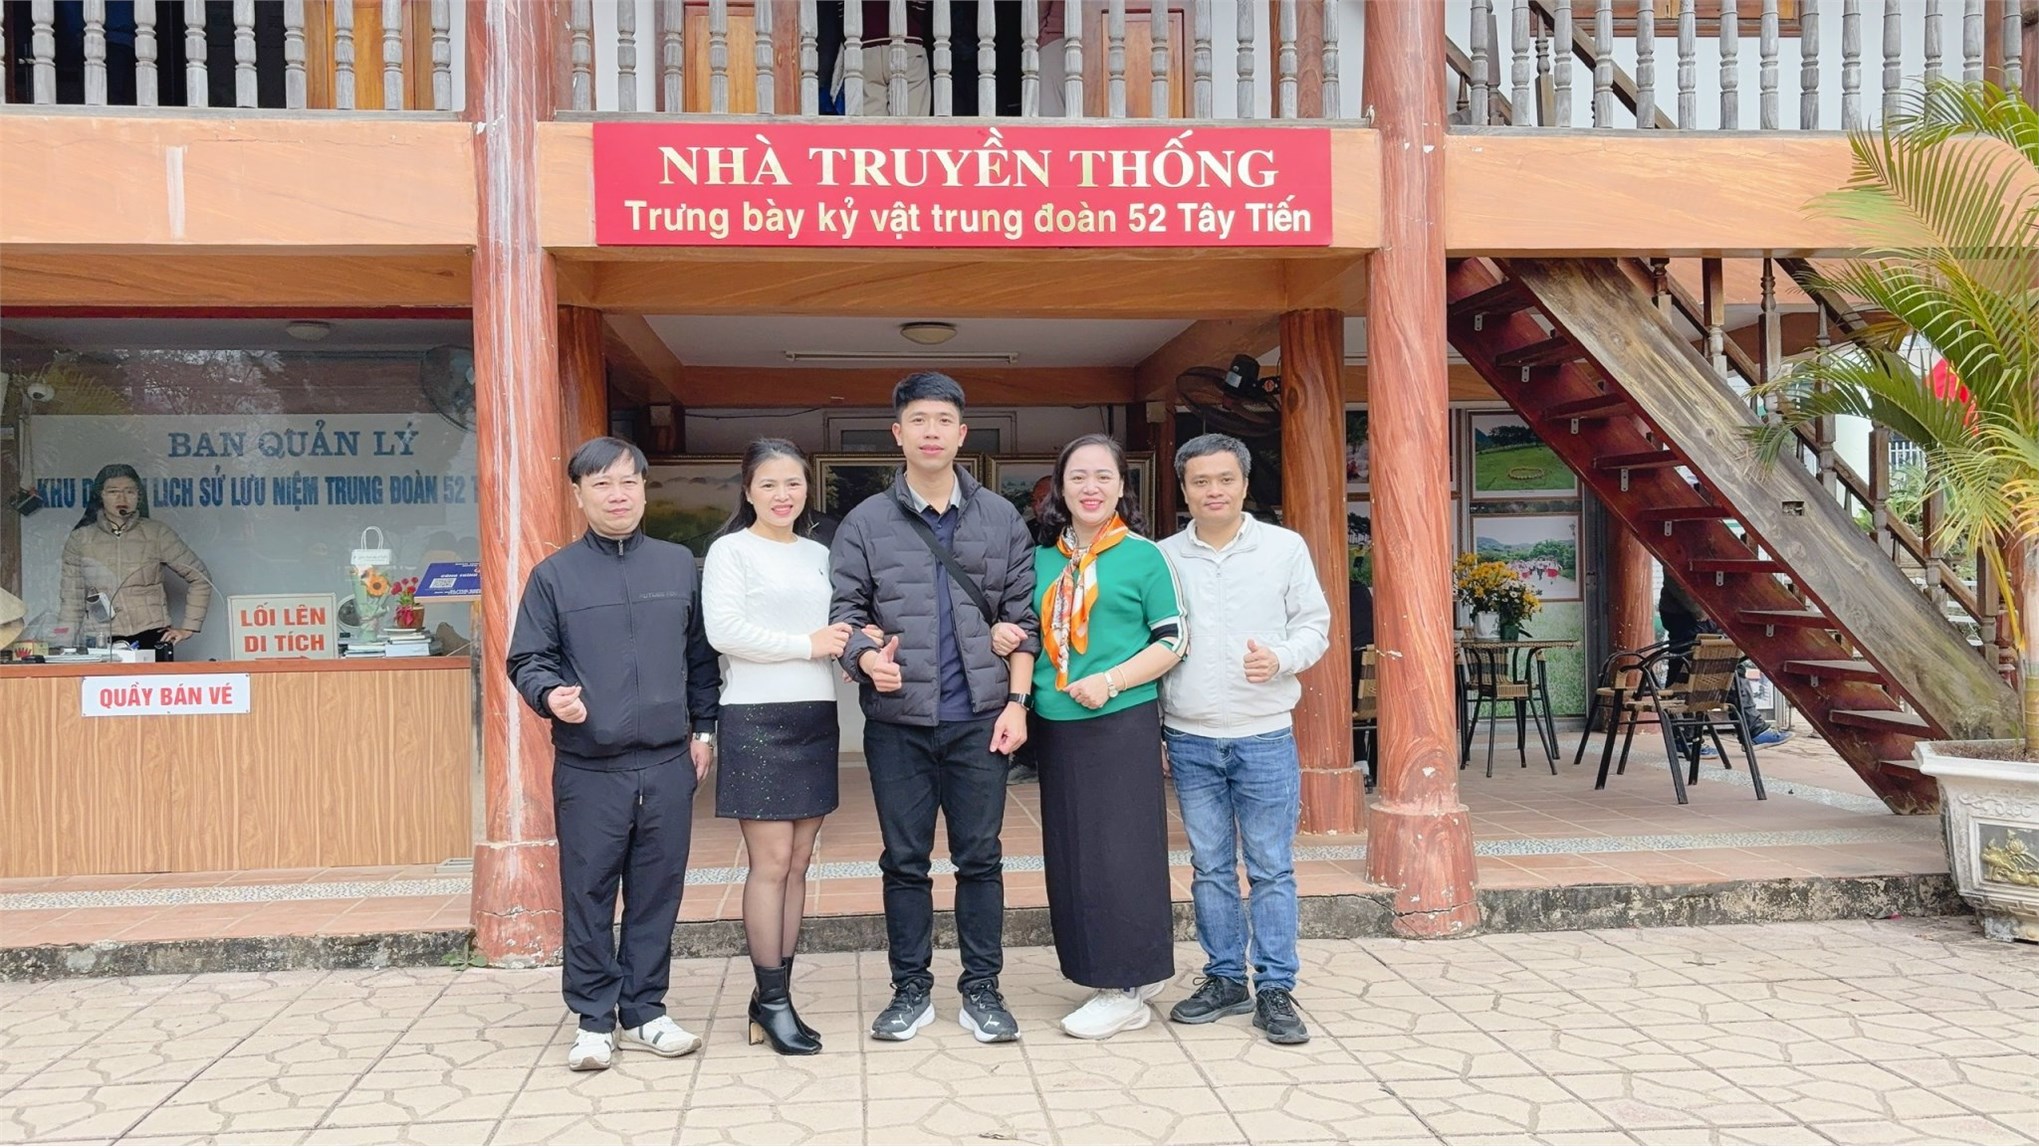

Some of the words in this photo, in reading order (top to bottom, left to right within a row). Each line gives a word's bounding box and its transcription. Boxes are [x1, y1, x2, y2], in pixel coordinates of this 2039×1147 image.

[658, 133, 793, 185] NHÀ
[809, 127, 1052, 188] TRUYỀN
[1069, 129, 1279, 188] THỐNG
[624, 199, 729, 238] Trưng
[743, 198, 805, 239] bày
[818, 196, 858, 239] kỷ
[870, 201, 920, 239] vật
[931, 203, 1023, 239] trung
[1034, 201, 1116, 233] đoàn
[1128, 203, 1167, 232] 52
[1177, 202, 1235, 239] Tây
[1245, 195, 1311, 233] Tiến
[168, 432, 247, 457] BAN
[258, 419, 360, 459] QUẢN
[373, 421, 419, 456] LÝ
[36, 477, 76, 508] KHU
[199, 464, 226, 508] SỬ
[231, 474, 266, 507] LƯU
[325, 475, 383, 506] TRUNG
[390, 469, 438, 505] ĐOÀN
[443, 475, 465, 504] 52
[240, 602, 276, 627] LỐI
[283, 604, 326, 626] LÊN
[244, 635, 267, 653] DI
[274, 631, 325, 652] TÍCH
[100, 682, 153, 709] QUẦY
[160, 683, 202, 706] BÁN
[209, 682, 233, 705] VÉ
